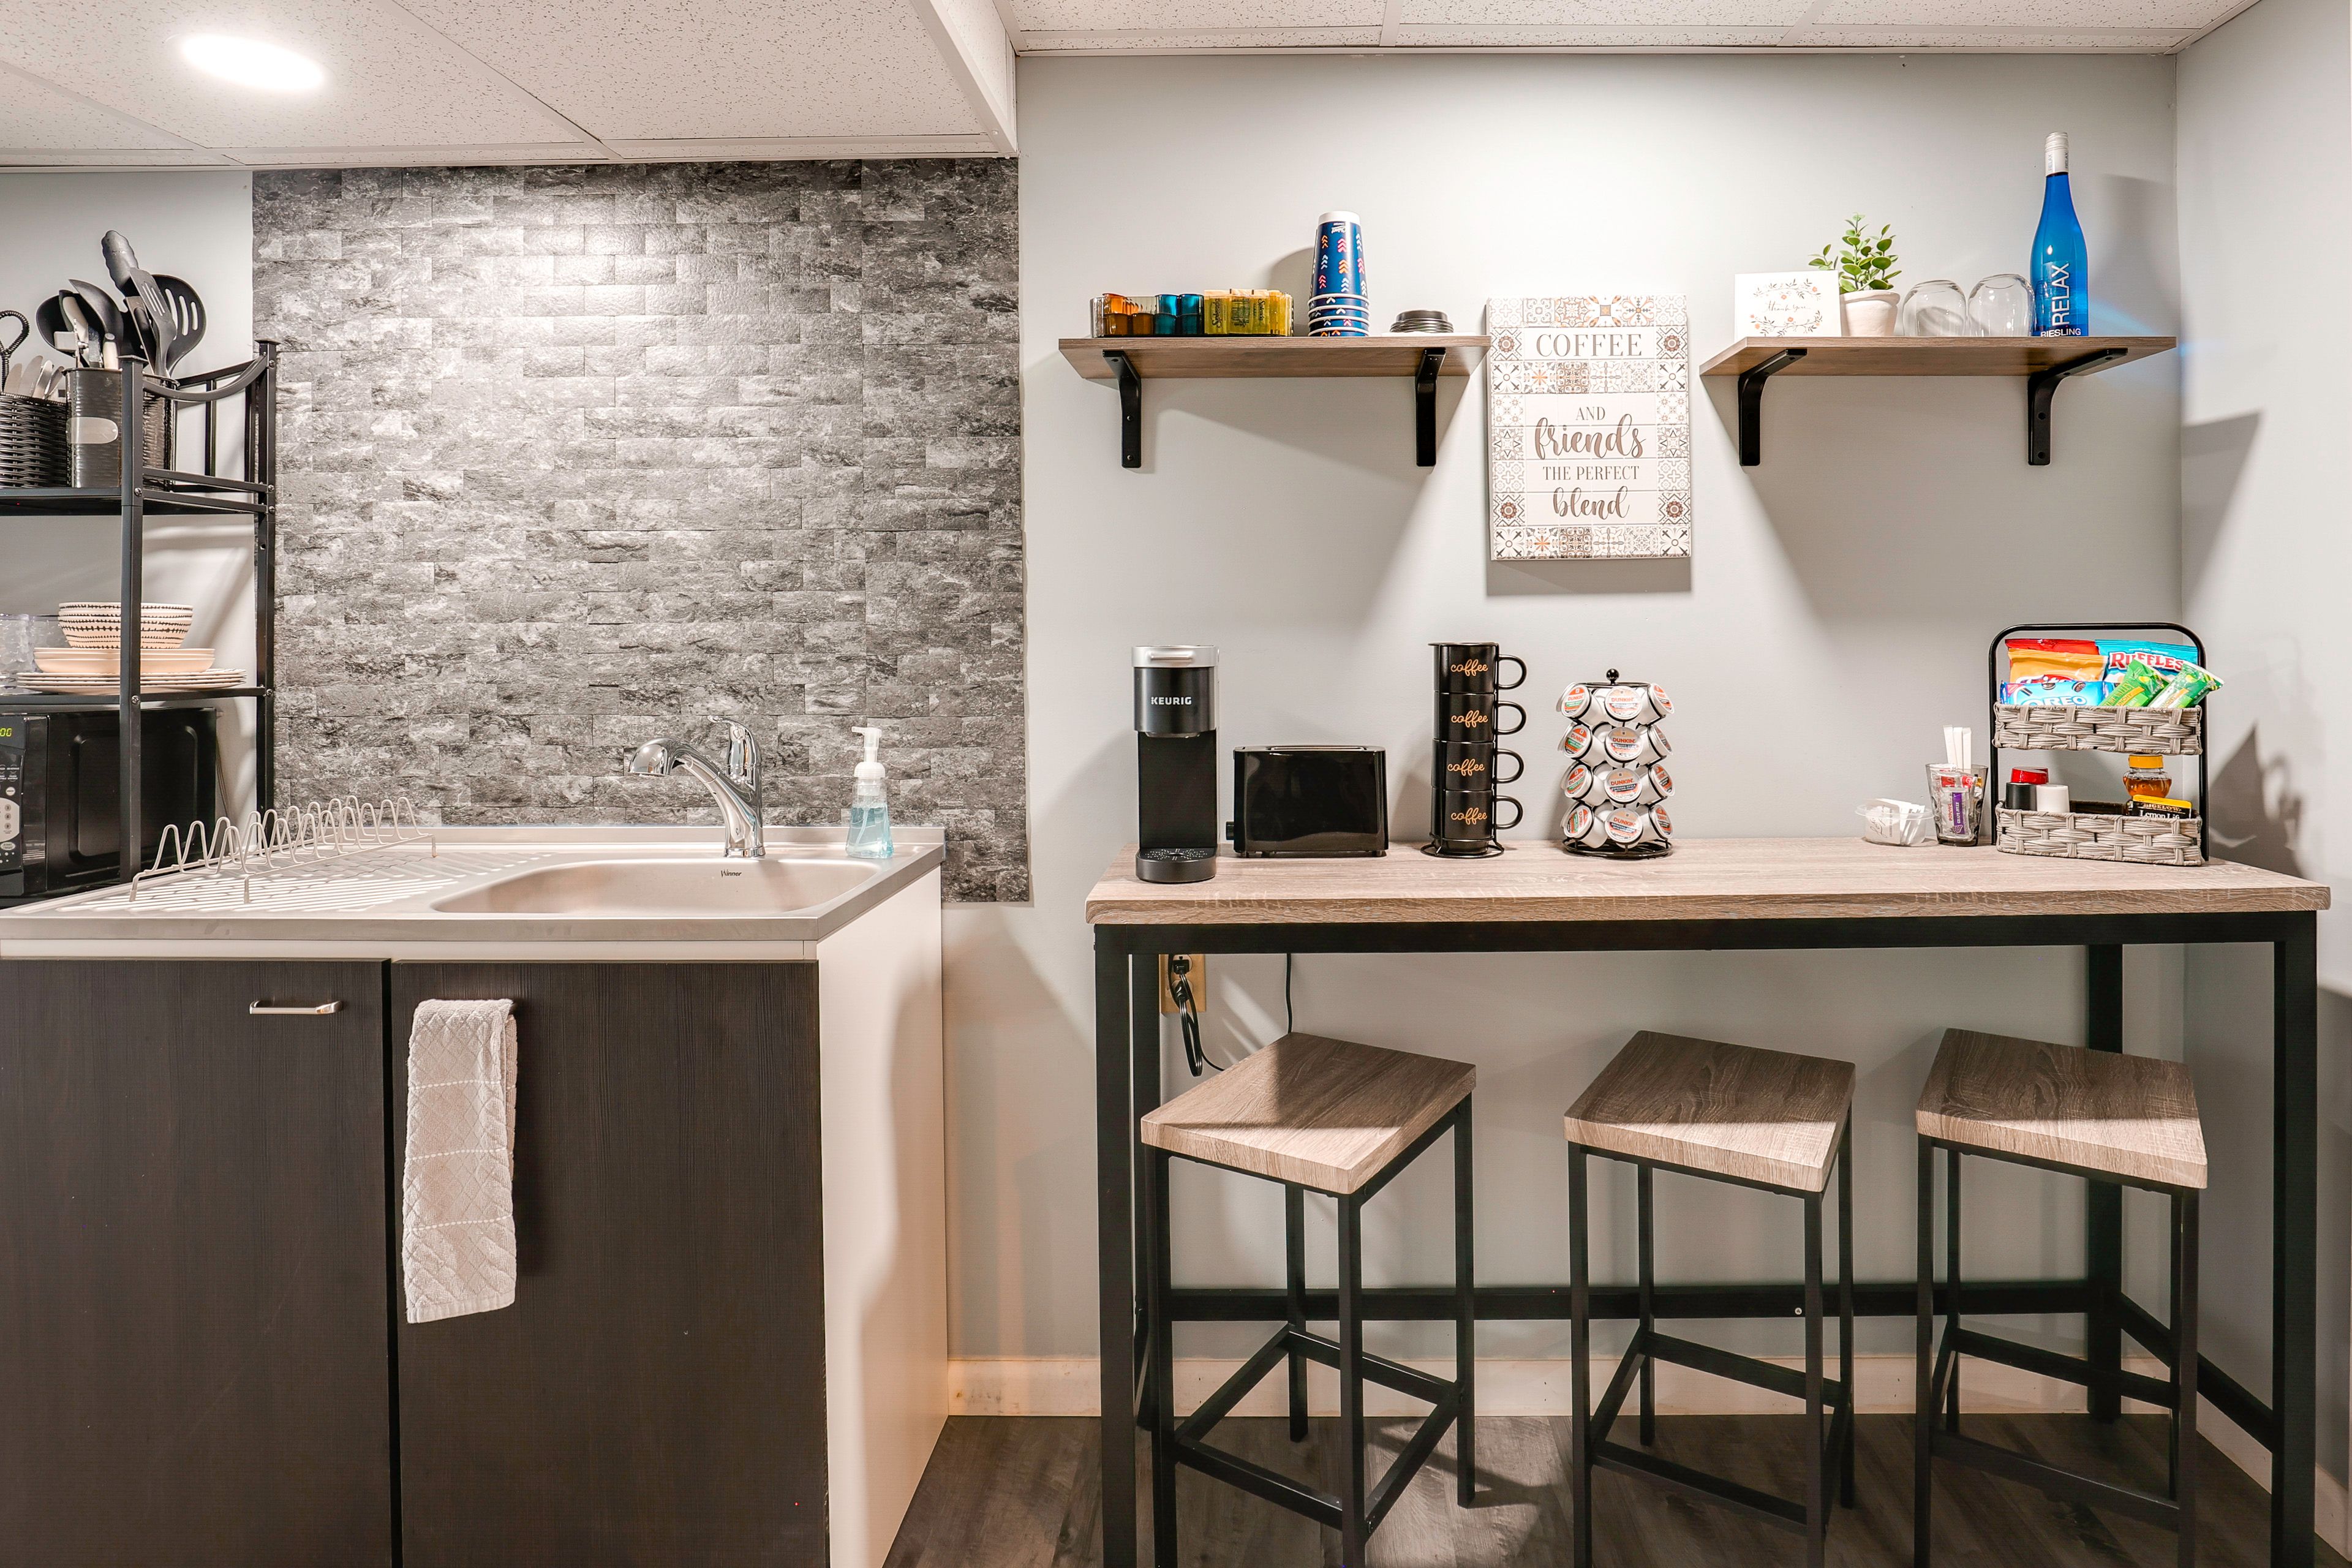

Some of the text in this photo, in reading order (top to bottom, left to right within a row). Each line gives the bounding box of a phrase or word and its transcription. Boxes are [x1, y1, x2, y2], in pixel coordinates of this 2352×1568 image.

[2051, 263, 2070, 326] RELAX
[2040, 328, 2081, 337] RIESLING
[1536, 334, 1642, 357] COFFEE
[1575, 406, 1605, 420] AND
[1535, 413, 1646, 460] friends
[1543, 466, 1640, 480] THE PERFECT
[1553, 486, 1630, 520] blend
[1450, 659, 1488, 677] coffee
[1151, 696, 1191, 705] KEURIG
[1451, 710, 1488, 728] coffee
[1447, 758, 1485, 776] coffee
[1450, 807, 1488, 825] coffee
[2139, 810, 2166, 818] Lemon
[720, 869, 742, 878] Winner
